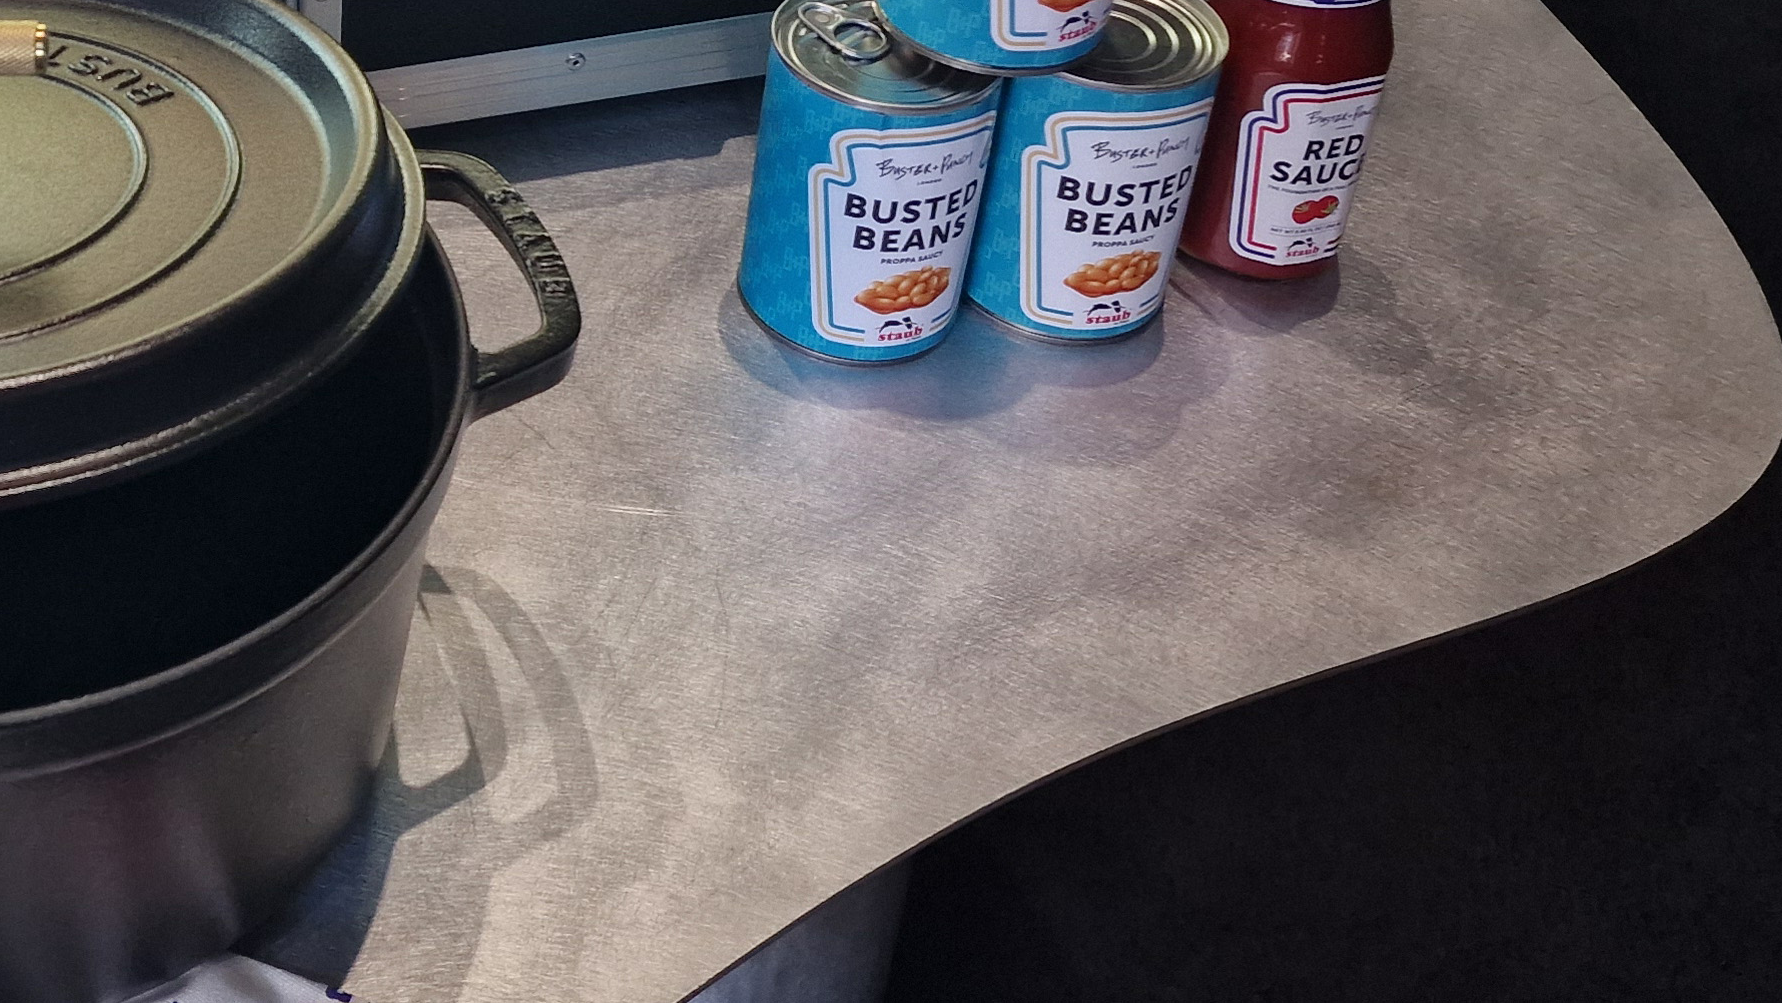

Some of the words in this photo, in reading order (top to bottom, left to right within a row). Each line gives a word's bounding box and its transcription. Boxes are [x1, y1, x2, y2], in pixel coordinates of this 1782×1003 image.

[1302, 133, 1365, 162] RED
[844, 179, 978, 224] BUSTED
[1056, 165, 1194, 207] BUSTED
[853, 212, 967, 253] BEANS
[1065, 197, 1181, 236] BEANS
[877, 326, 923, 342] staub
[1085, 310, 1132, 325] staub
